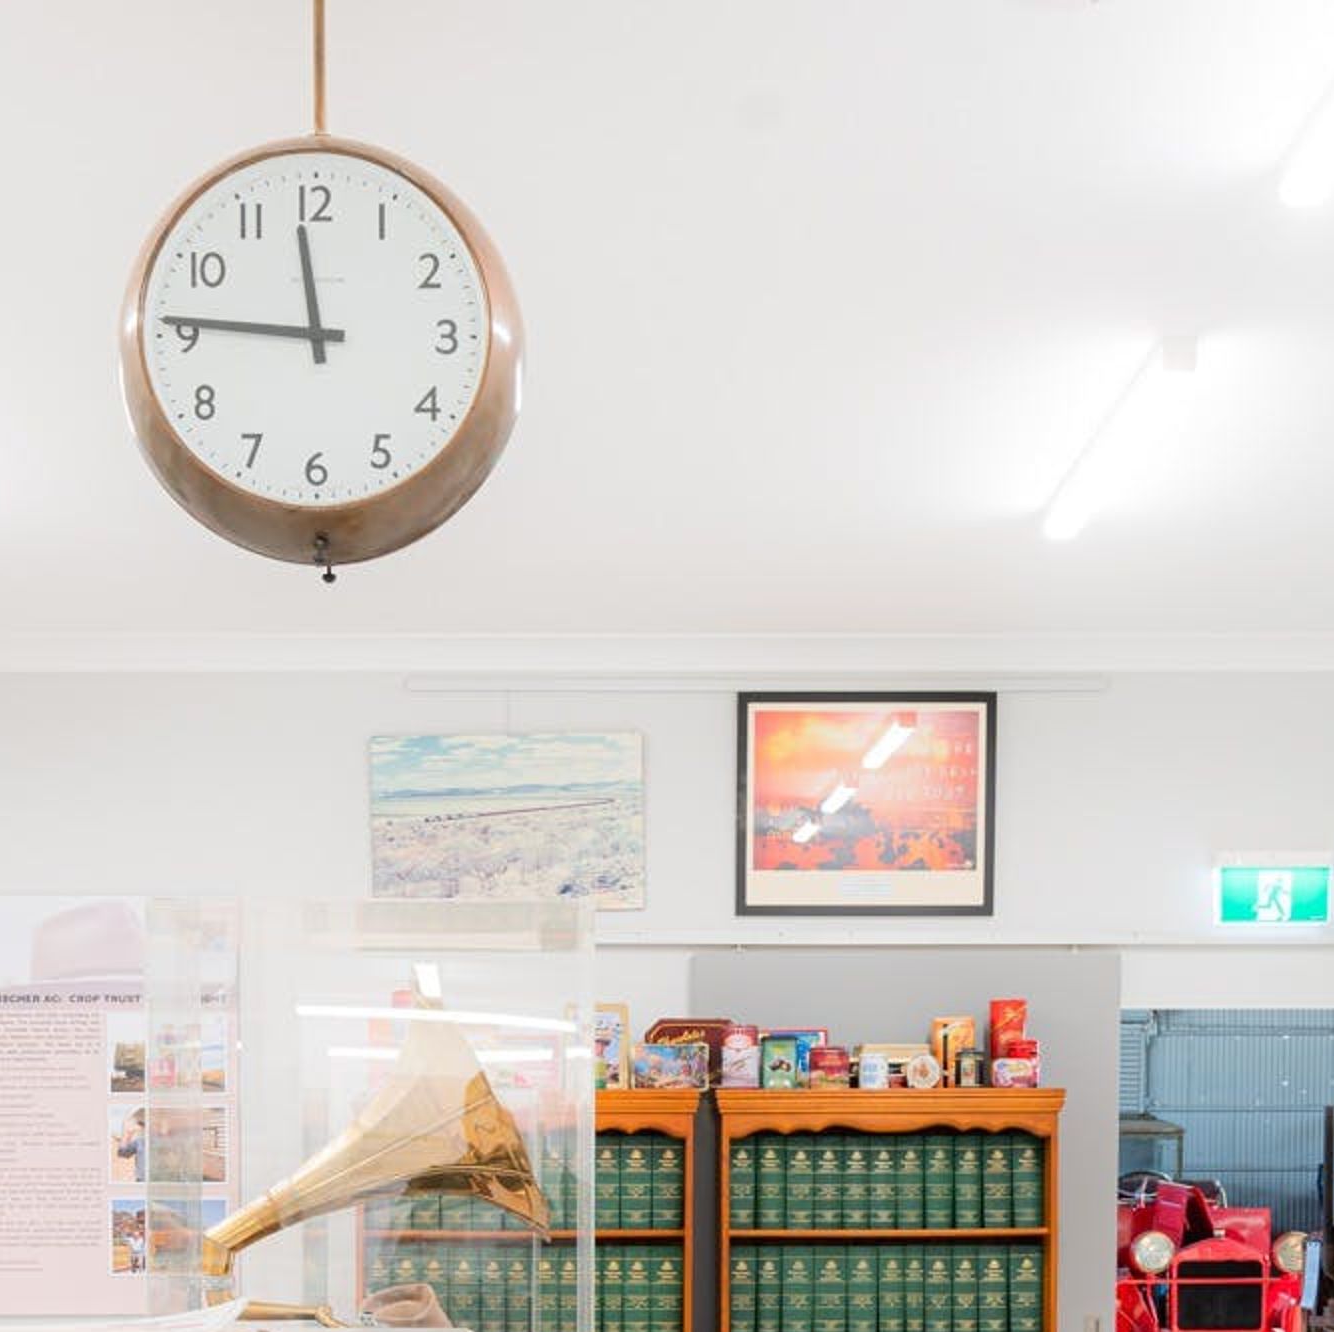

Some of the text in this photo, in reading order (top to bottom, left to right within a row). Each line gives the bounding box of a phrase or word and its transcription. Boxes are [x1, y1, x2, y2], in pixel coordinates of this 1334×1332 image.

[240, 203, 262, 240] 11
[298, 185, 333, 222] 12
[377, 203, 386, 240] 1
[189, 251, 227, 288] 10
[417, 253, 442, 289] 2
[175, 322, 200, 353] 9
[434, 320, 458, 354] 3
[193, 384, 216, 420] 8
[413, 385, 441, 422] 4
[240, 433, 264, 469] 7
[304, 451, 328, 486] 6
[369, 433, 392, 469] 5
